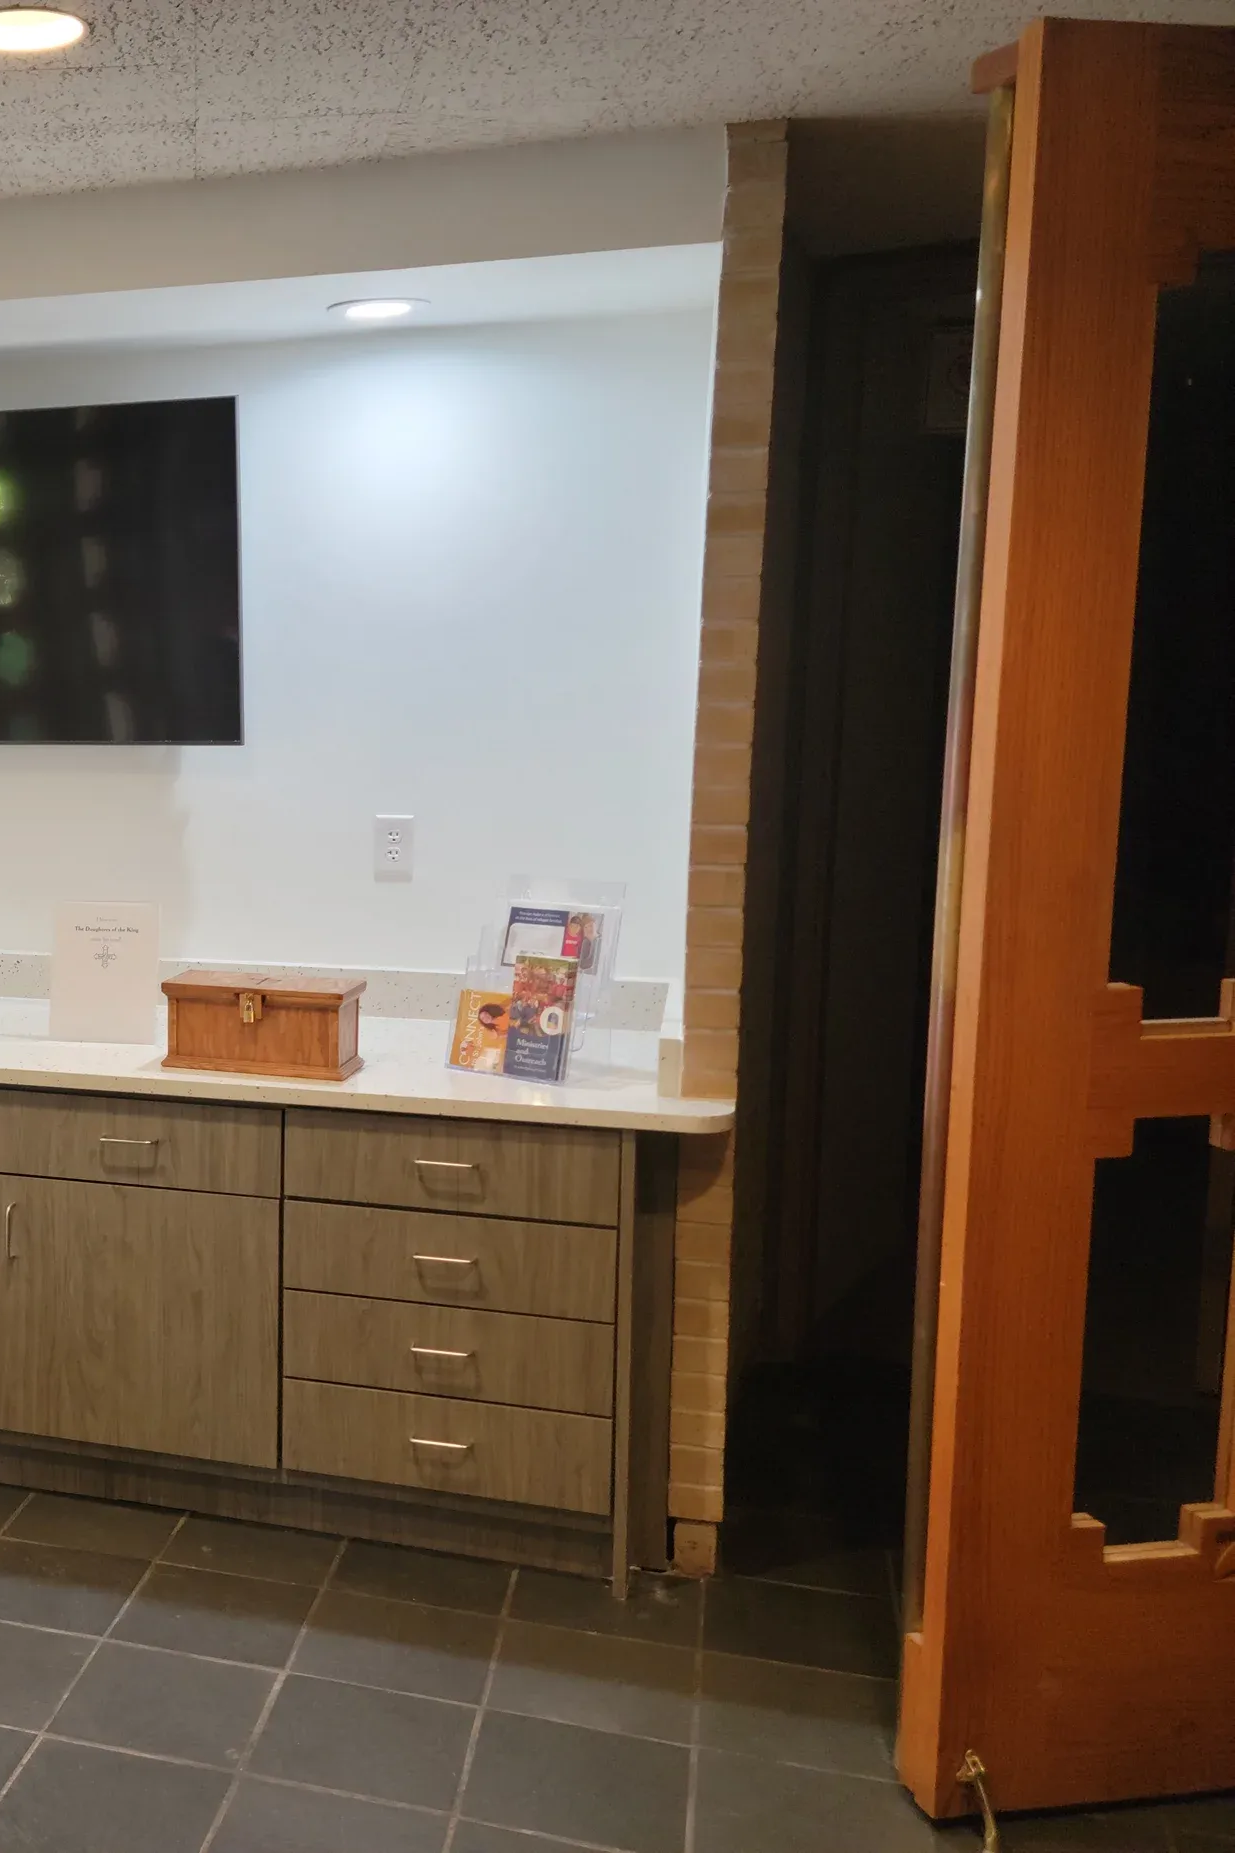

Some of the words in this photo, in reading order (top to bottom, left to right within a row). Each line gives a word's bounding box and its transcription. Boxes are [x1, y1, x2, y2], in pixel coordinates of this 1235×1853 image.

[126, 926, 139, 934] King
[516, 1038, 549, 1050] Ministries
[514, 1054, 547, 1066] Outreach
